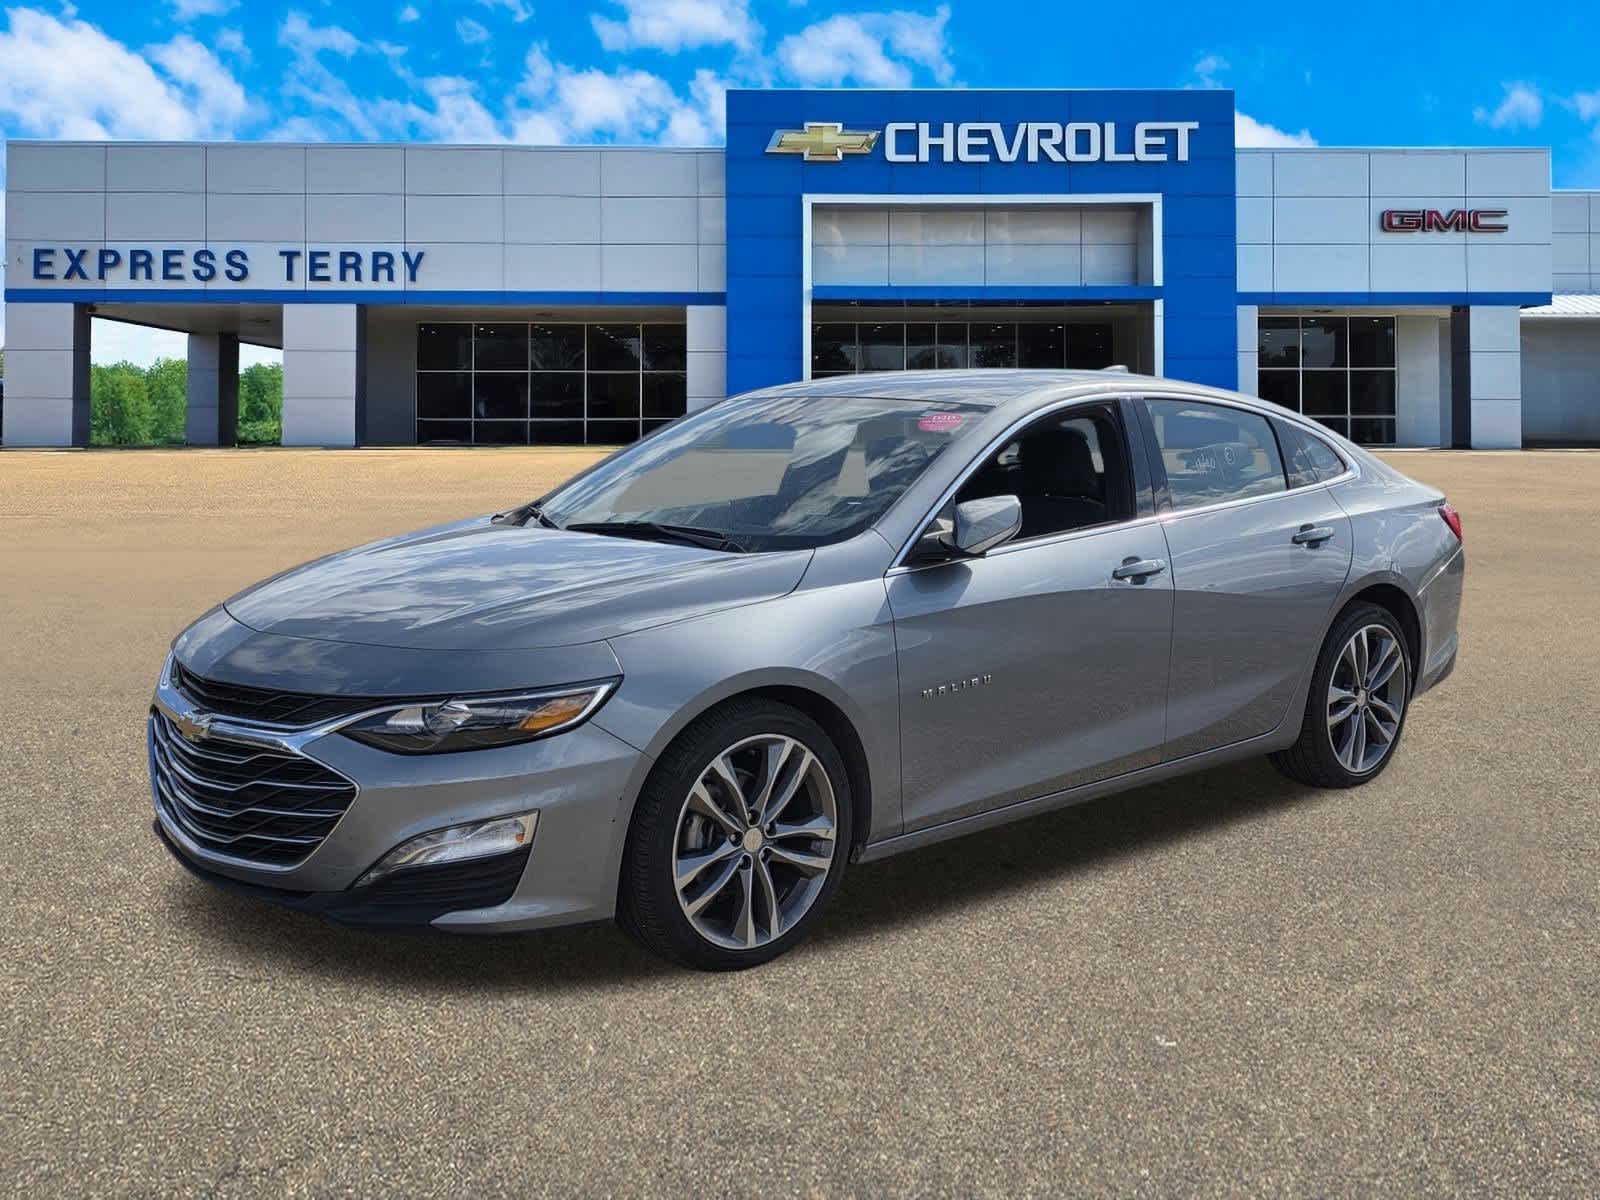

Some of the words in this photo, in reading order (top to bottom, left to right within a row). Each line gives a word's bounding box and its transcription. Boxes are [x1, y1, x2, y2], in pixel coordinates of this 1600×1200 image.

[885, 121, 1199, 162] CHEVROLET
[1382, 209, 1509, 232] GMC
[33, 248, 249, 282] EXPRESS
[279, 250, 425, 283] TERRY
[921, 673, 992, 699] MALIBU
